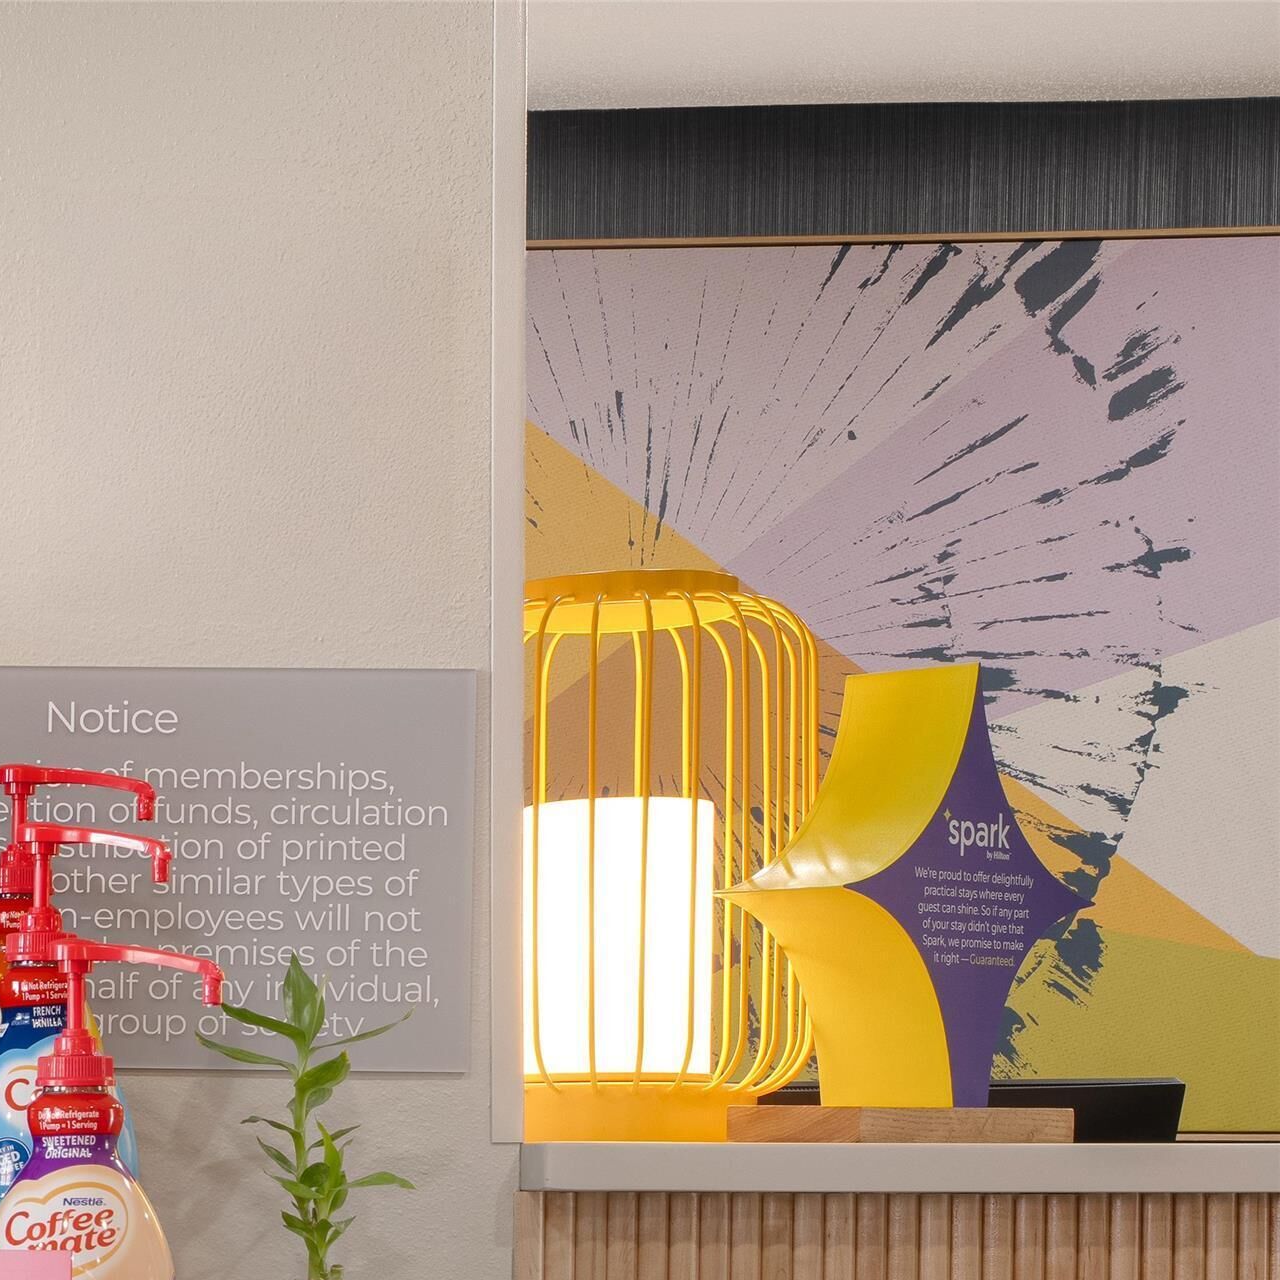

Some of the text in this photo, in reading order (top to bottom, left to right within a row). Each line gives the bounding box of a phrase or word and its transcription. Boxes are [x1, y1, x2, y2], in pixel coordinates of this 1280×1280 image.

[47, 700, 179, 734] Notice
[144, 762, 395, 796] memberships,
[153, 797, 259, 829] funds,
[270, 797, 449, 827] circulation
[948, 813, 1010, 857] spark
[237, 833, 271, 861] of
[282, 833, 406, 867] printed
[987, 850, 1010, 861] by Hilton
[52, 866, 142, 895] other
[152, 866, 266, 896] similar
[277, 868, 373, 902] types
[384, 868, 420, 897] of
[914, 866, 1034, 889] We're proud to offer delightfully
[924, 885, 1025, 905] practical stays where every
[59, 904, 285, 937] n-employees
[294, 903, 350, 932] will
[364, 906, 422, 933] not
[918, 902, 1030, 921] guest can shine. So if any part
[922, 917, 1024, 936] of your stay didn't give that
[922, 934, 1024, 951] Spark, we promise to make
[326, 939, 361, 967] of
[369, 939, 428, 968] the
[933, 951, 939, 963] it
[941, 951, 960, 965] right
[29, 981, 39, 989] Not
[40, 980, 68, 990] Refrigera
[148, 972, 183, 999] of
[25, 993, 40, 1001] Pump
[32, 1006, 61, 1016] FRENCH
[31, 1017, 62, 1028] VANILLA
[60, 1110, 99, 1120] Refrigerate
[43, 1122, 60, 1131] Pump
[71, 1121, 98, 1130] Serving
[42, 1135, 96, 1147] SWEETENED
[45, 1147, 92, 1159] ORIGINAL
[5, 1208, 114, 1246] Coffee
